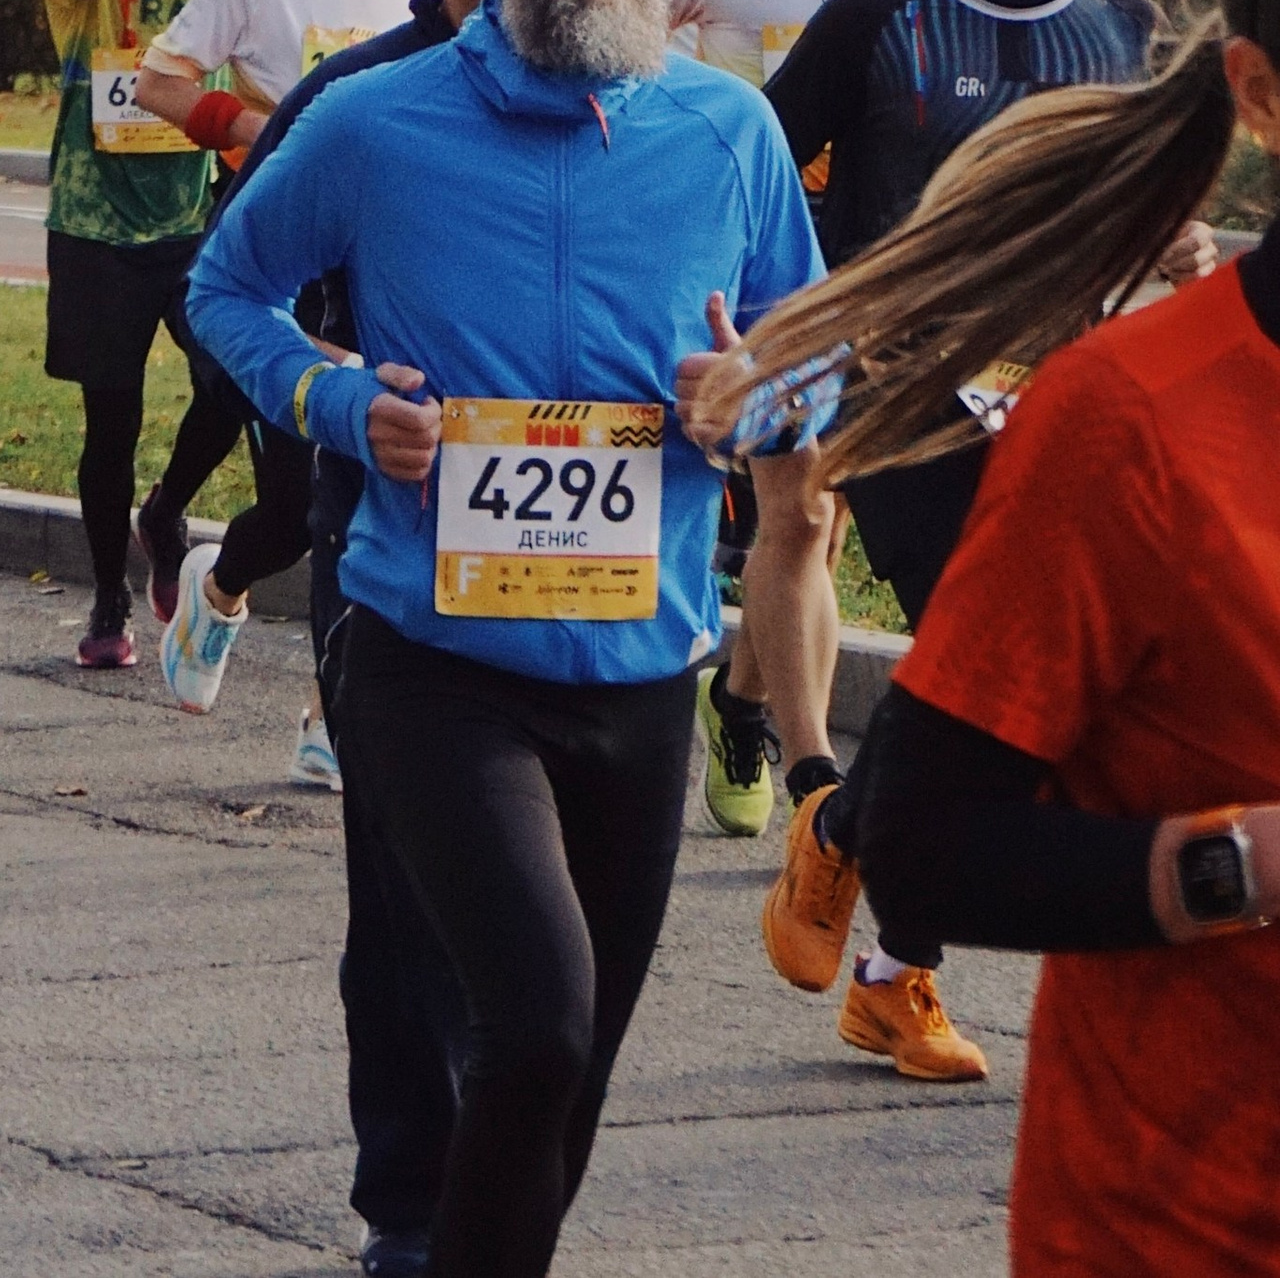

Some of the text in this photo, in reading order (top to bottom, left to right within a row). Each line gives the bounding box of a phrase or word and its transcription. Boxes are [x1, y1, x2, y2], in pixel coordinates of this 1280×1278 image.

[468, 457, 636, 523] 4296
[518, 529, 588, 549] ДЕНИС
[458, 558, 483, 596] F
